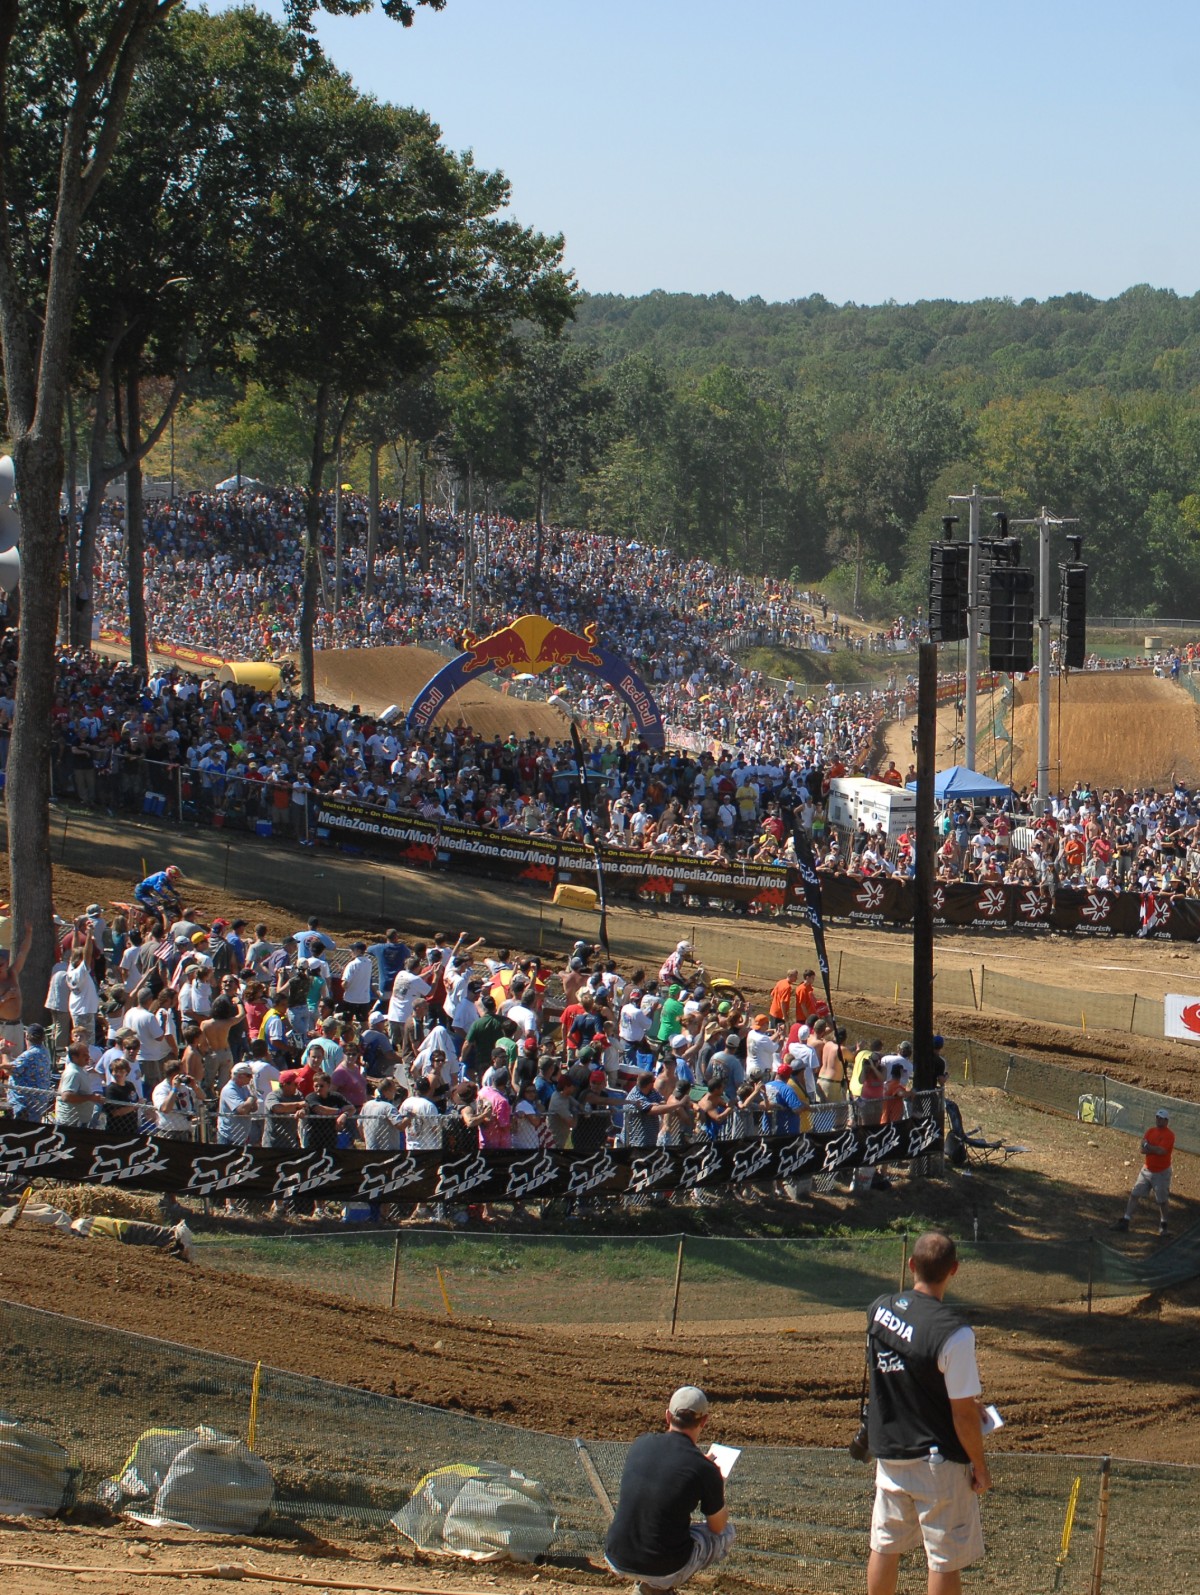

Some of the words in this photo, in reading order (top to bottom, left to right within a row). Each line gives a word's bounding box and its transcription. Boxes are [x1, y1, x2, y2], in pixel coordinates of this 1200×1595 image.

[419, 686, 444, 716] Bull
[620, 675, 645, 702] Red
[638, 698, 658, 726] Bull
[322, 801, 345, 811] Watch
[347, 806, 364, 814] LIVE
[382, 813, 412, 824] Demand
[438, 836, 556, 866] MediaZone.com/Moto
[442, 826, 465, 834] Watch
[467, 829, 483, 837] LIVE
[502, 836, 530, 845] Demand
[532, 840, 557, 850] Racing
[674, 868, 786, 889] MediaZone.com/Moto
[676, 856, 698, 864] Watch
[733, 863, 762, 871] Demand
[762, 866, 788, 874] Racing
[849, 911, 884, 920] Asterisk
[972, 918, 1006, 926] Asterisk
[1014, 920, 1050, 928] Asterisk
[1076, 924, 1111, 932] Asterisk
[3, 1146, 77, 1172] FOX
[90, 1158, 170, 1184] FOX
[678, 1158, 722, 1188] FOX
[732, 1152, 772, 1182] FOX
[186, 1166, 264, 1194] FOX
[268, 1168, 343, 1199] FOX
[355, 1170, 425, 1199] FOX
[431, 1168, 494, 1199] FOX
[506, 1166, 560, 1198] FOX
[566, 1166, 618, 1195] FOX
[625, 1162, 676, 1193] FOX
